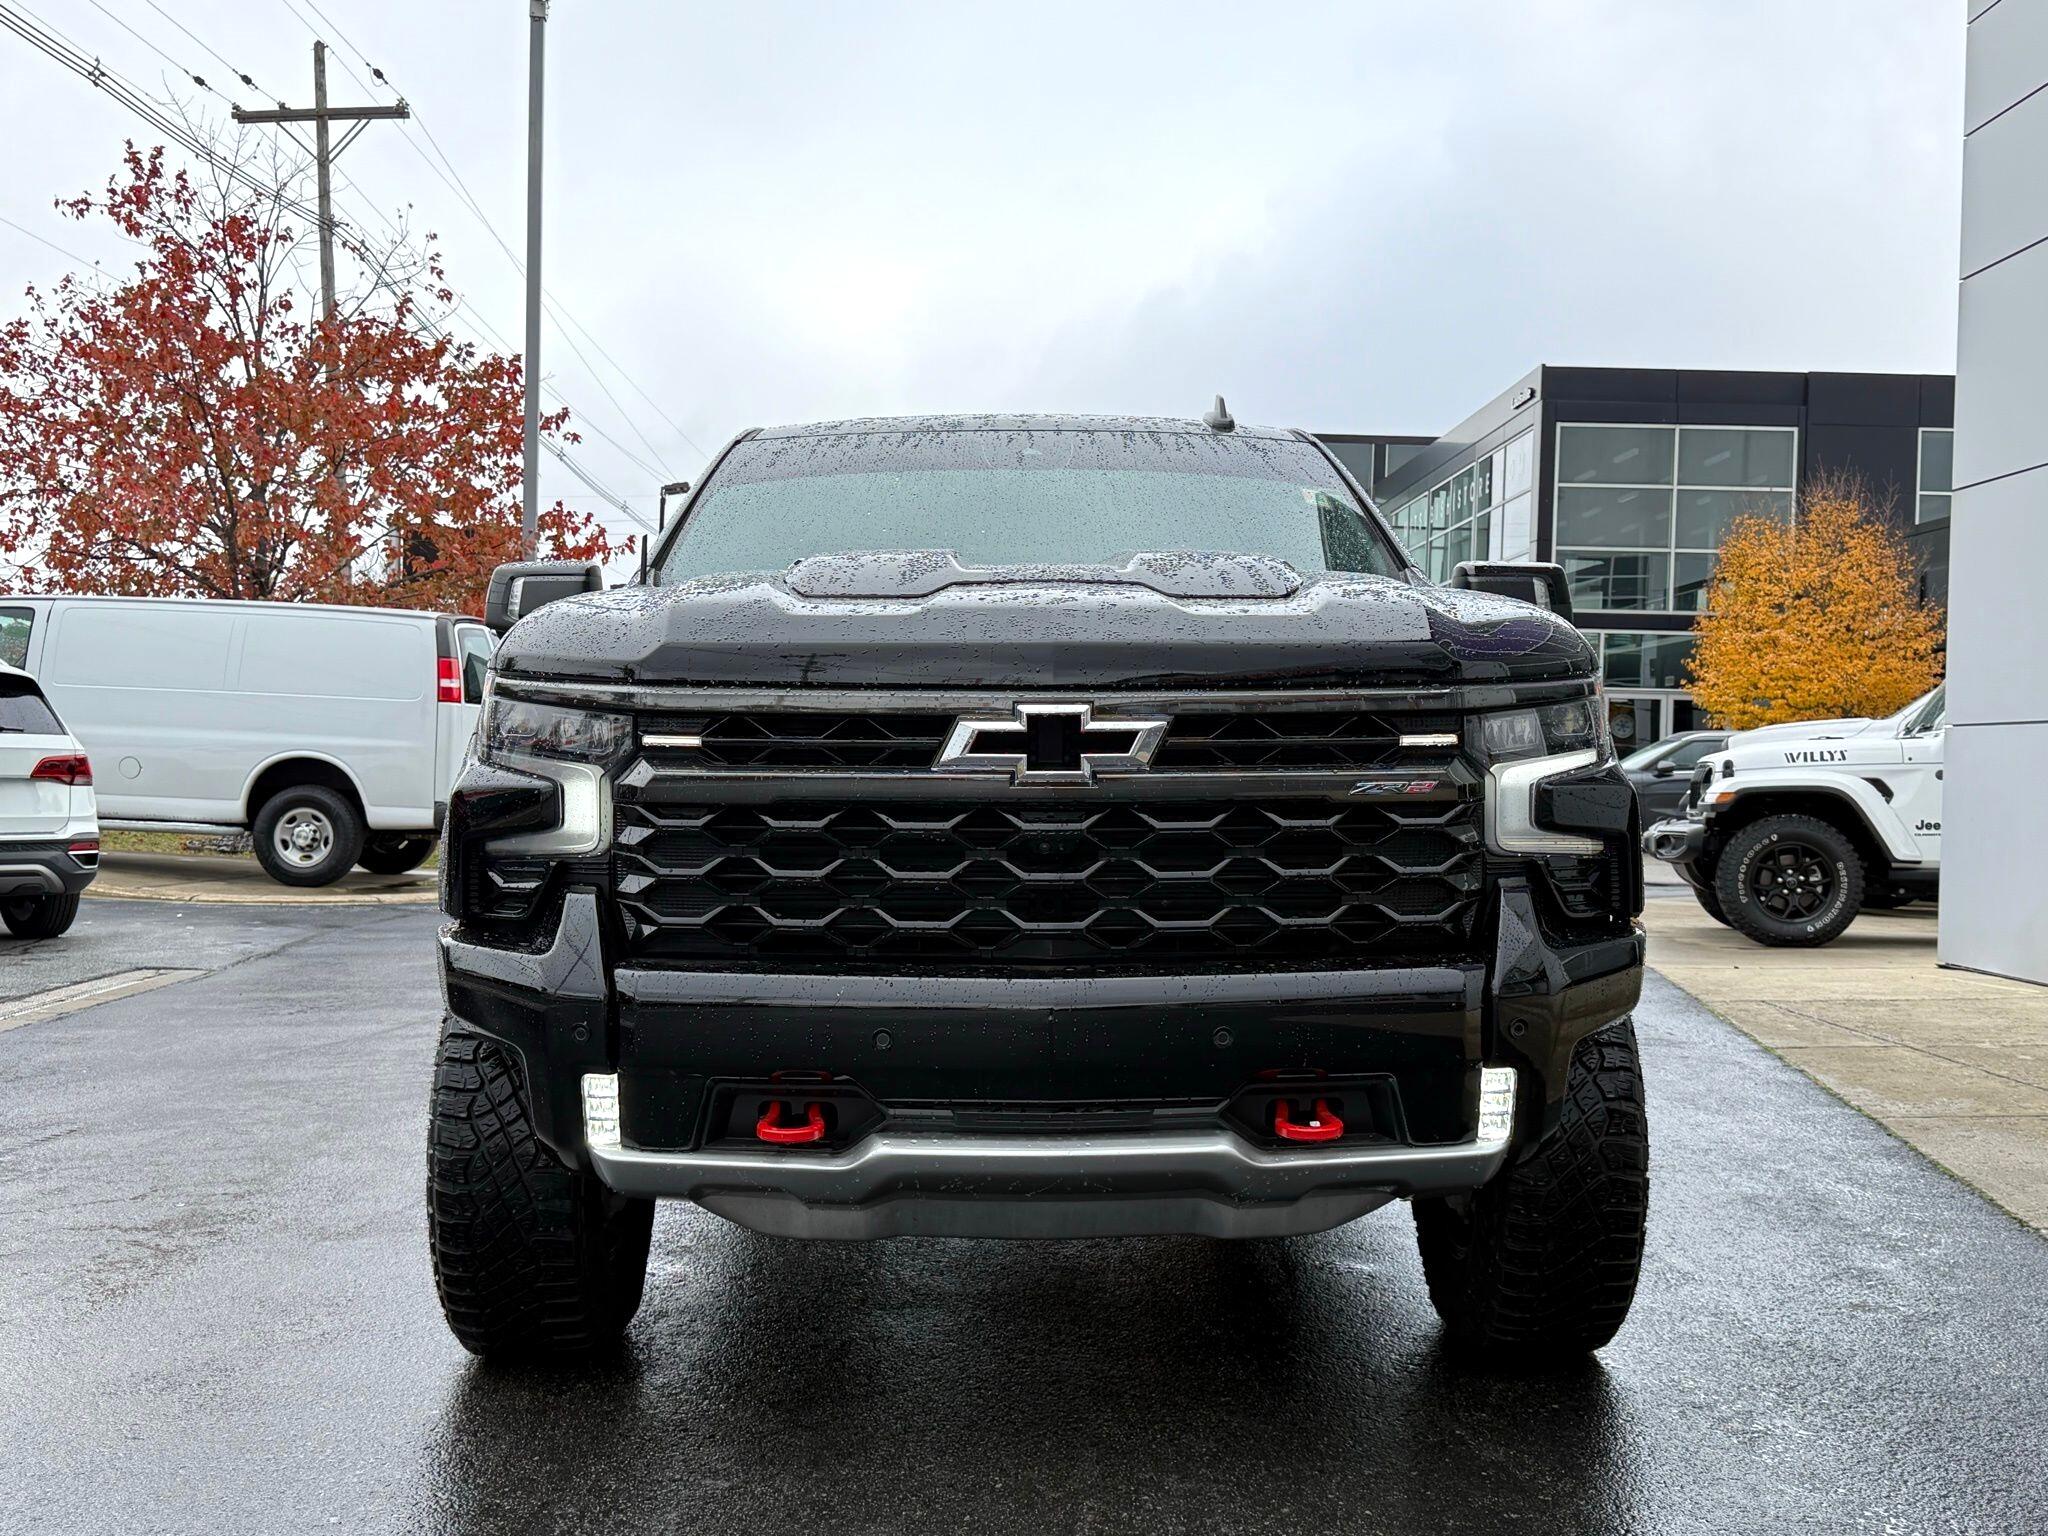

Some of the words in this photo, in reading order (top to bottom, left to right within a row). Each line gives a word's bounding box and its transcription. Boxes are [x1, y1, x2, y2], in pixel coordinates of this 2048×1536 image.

[1784, 749, 1848, 763] WILLYS
[1348, 780, 1439, 796] ZR2
[1915, 819, 1941, 831] Jee
